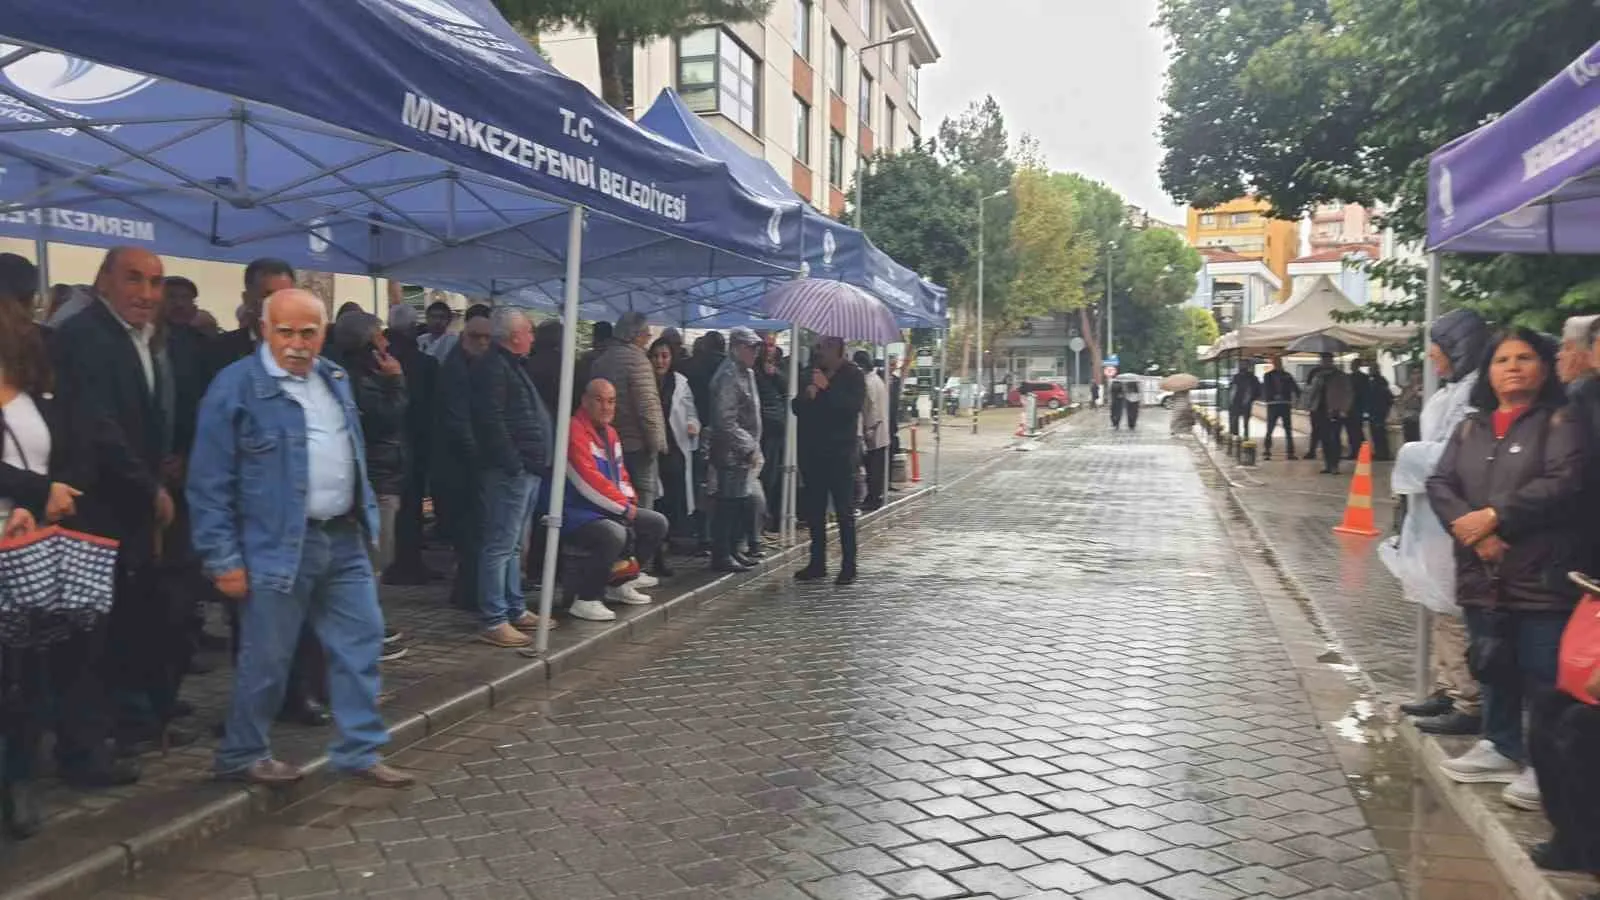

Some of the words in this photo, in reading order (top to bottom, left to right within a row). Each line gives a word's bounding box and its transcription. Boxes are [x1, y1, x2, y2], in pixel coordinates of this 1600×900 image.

[401, 92, 596, 189] MERKEZEFENDİ
[599, 167, 686, 222] BELEDİYESİ
[559, 107, 599, 146] T.C.
